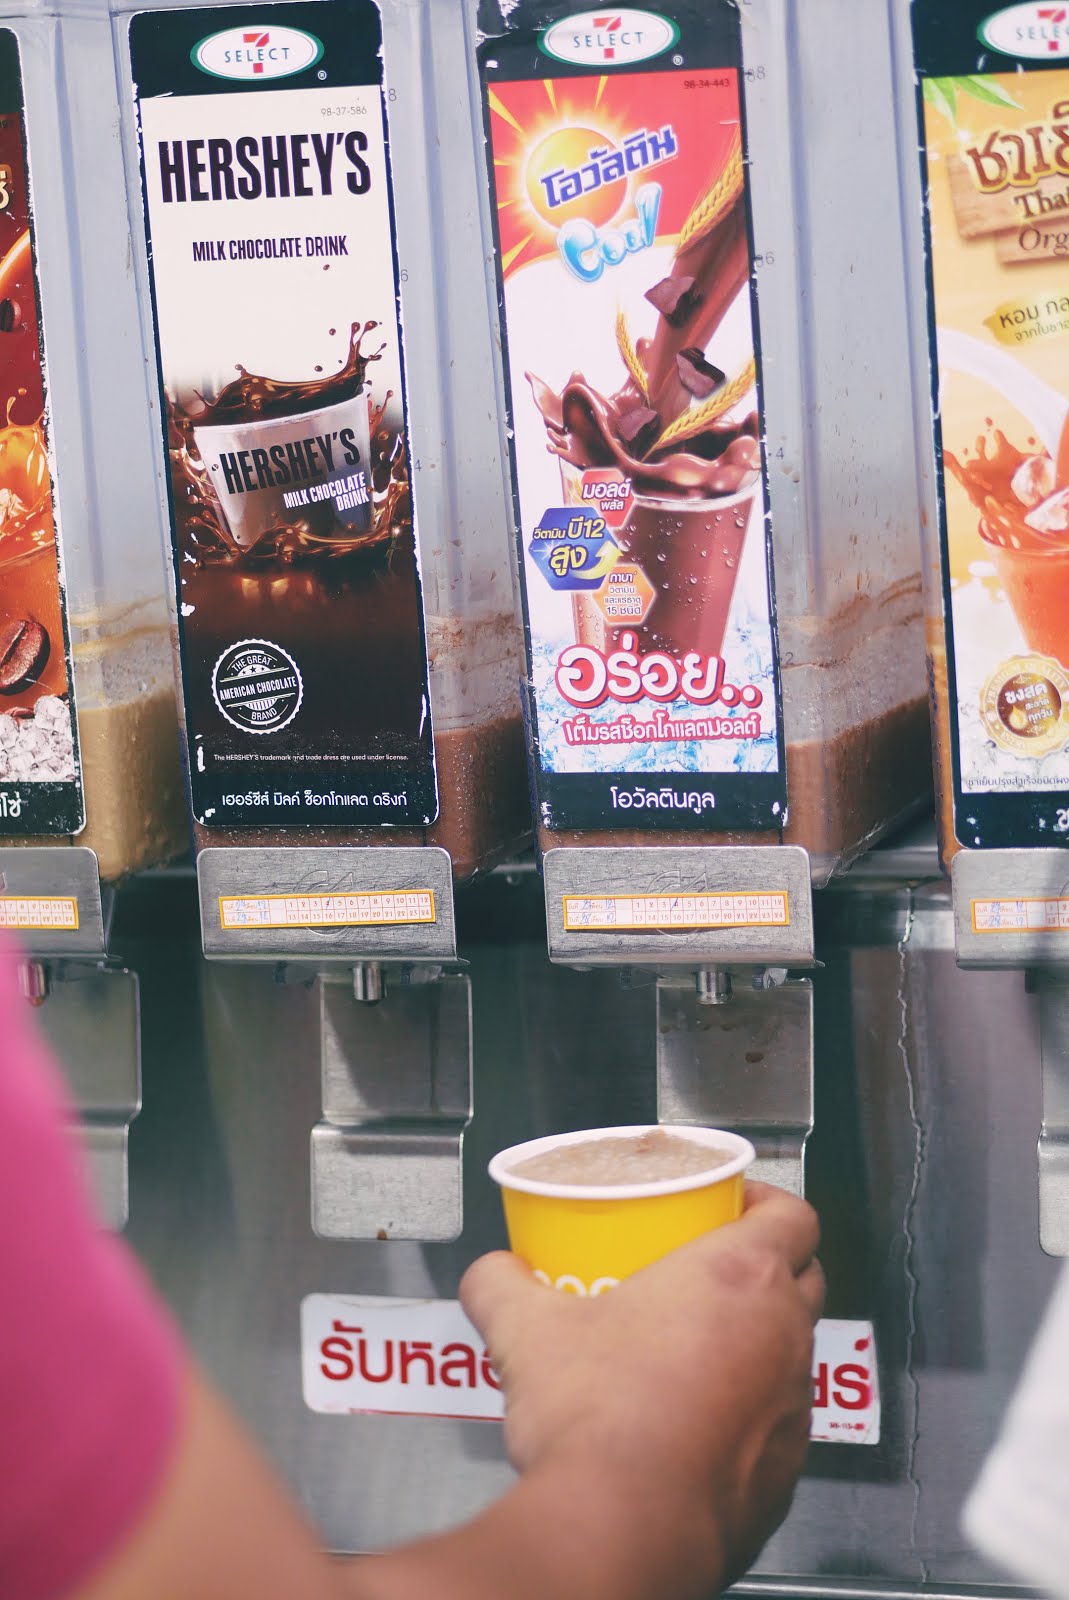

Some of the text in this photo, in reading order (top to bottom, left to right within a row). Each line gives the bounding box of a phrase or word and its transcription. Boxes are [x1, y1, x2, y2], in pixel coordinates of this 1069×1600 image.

[573, 31, 644, 48] SELECT
[224, 47, 290, 63] SELECT
[388, 88, 397, 102] 8
[320, 106, 367, 117] 98-37-586
[158, 130, 372, 204] HERSHEY'S
[540, 126, 679, 209] โอวัลติน
[556, 181, 662, 284] Cool
[192, 235, 349, 262] MILK CHOCOLATE DRINK
[400, 268, 409, 282] 6
[219, 428, 361, 495] HERSHEY'S
[776, 447, 784, 459] 4
[414, 459, 422, 471] 4
[283, 471, 366, 508] MILK CHOCOLATE
[583, 479, 631, 498] มอลต์
[334, 487, 369, 511] DRINK
[533, 516, 605, 540] วิตามิน บี12
[550, 545, 588, 577] สูง
[607, 605, 641, 615] 15 ชนิด
[231, 655, 273, 672] THE GREAT
[785, 651, 794, 665] 2
[220, 676, 297, 701] AMERICAN CHOCOLATE
[251, 707, 277, 721] BRAND
[274, 792, 300, 806] มิลค์
[304, 790, 369, 806] ช็อกโกแลต
[372, 792, 407, 806] ดริงก์
[610, 786, 715, 814] โอวัลตินคูล
[774, 898, 782, 906] 12
[635, 914, 643, 922] 13
